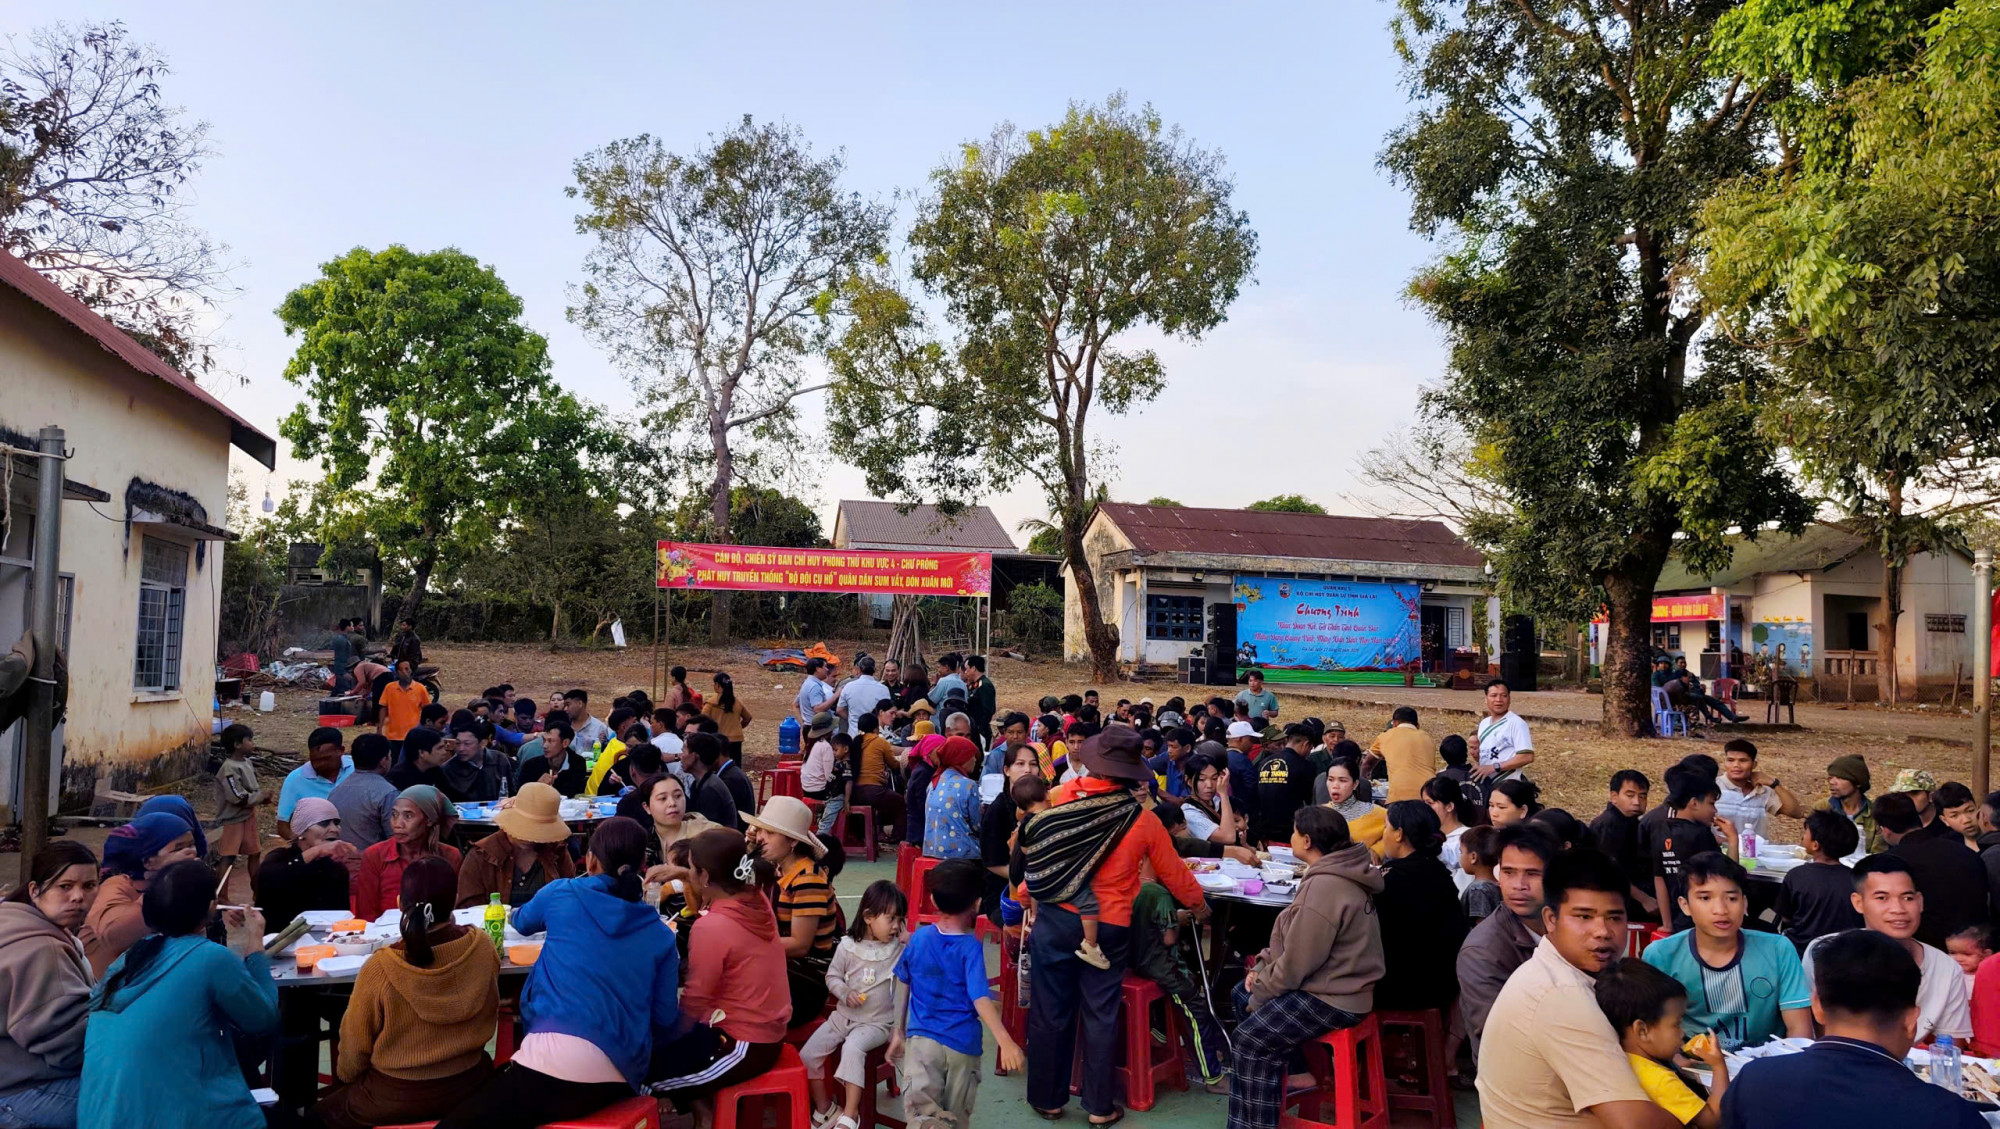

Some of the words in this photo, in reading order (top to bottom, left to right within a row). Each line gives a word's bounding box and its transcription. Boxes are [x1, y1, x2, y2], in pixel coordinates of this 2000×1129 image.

[714, 552, 730, 563] CÁN
[732, 552, 743, 566] BỘ,
[744, 551, 766, 565] CHIẾN
[778, 554, 792, 566] BAN
[794, 552, 805, 566] CHỈ
[807, 556, 820, 566] HUY
[861, 557, 874, 568] KHU
[876, 558, 889, 571] VỰC
[901, 558, 915, 569] CHƯ
[697, 568, 715, 580] PHÁT
[717, 570, 731, 582] HUY
[761, 569, 783, 583] THỐNG
[799, 572, 811, 586] ĐỘI
[813, 574, 822, 586] CỤ
[838, 572, 857, 586] QUÂN
[858, 574, 872, 586] DÂN
[874, 576, 889, 586] SUM
[906, 575, 919, 587] ĐÓN
[921, 576, 939, 588] XUÂN
[940, 576, 953, 588] MỚI
[1296, 603, 1331, 619] Chương
[1334, 604, 1360, 617] Trình
